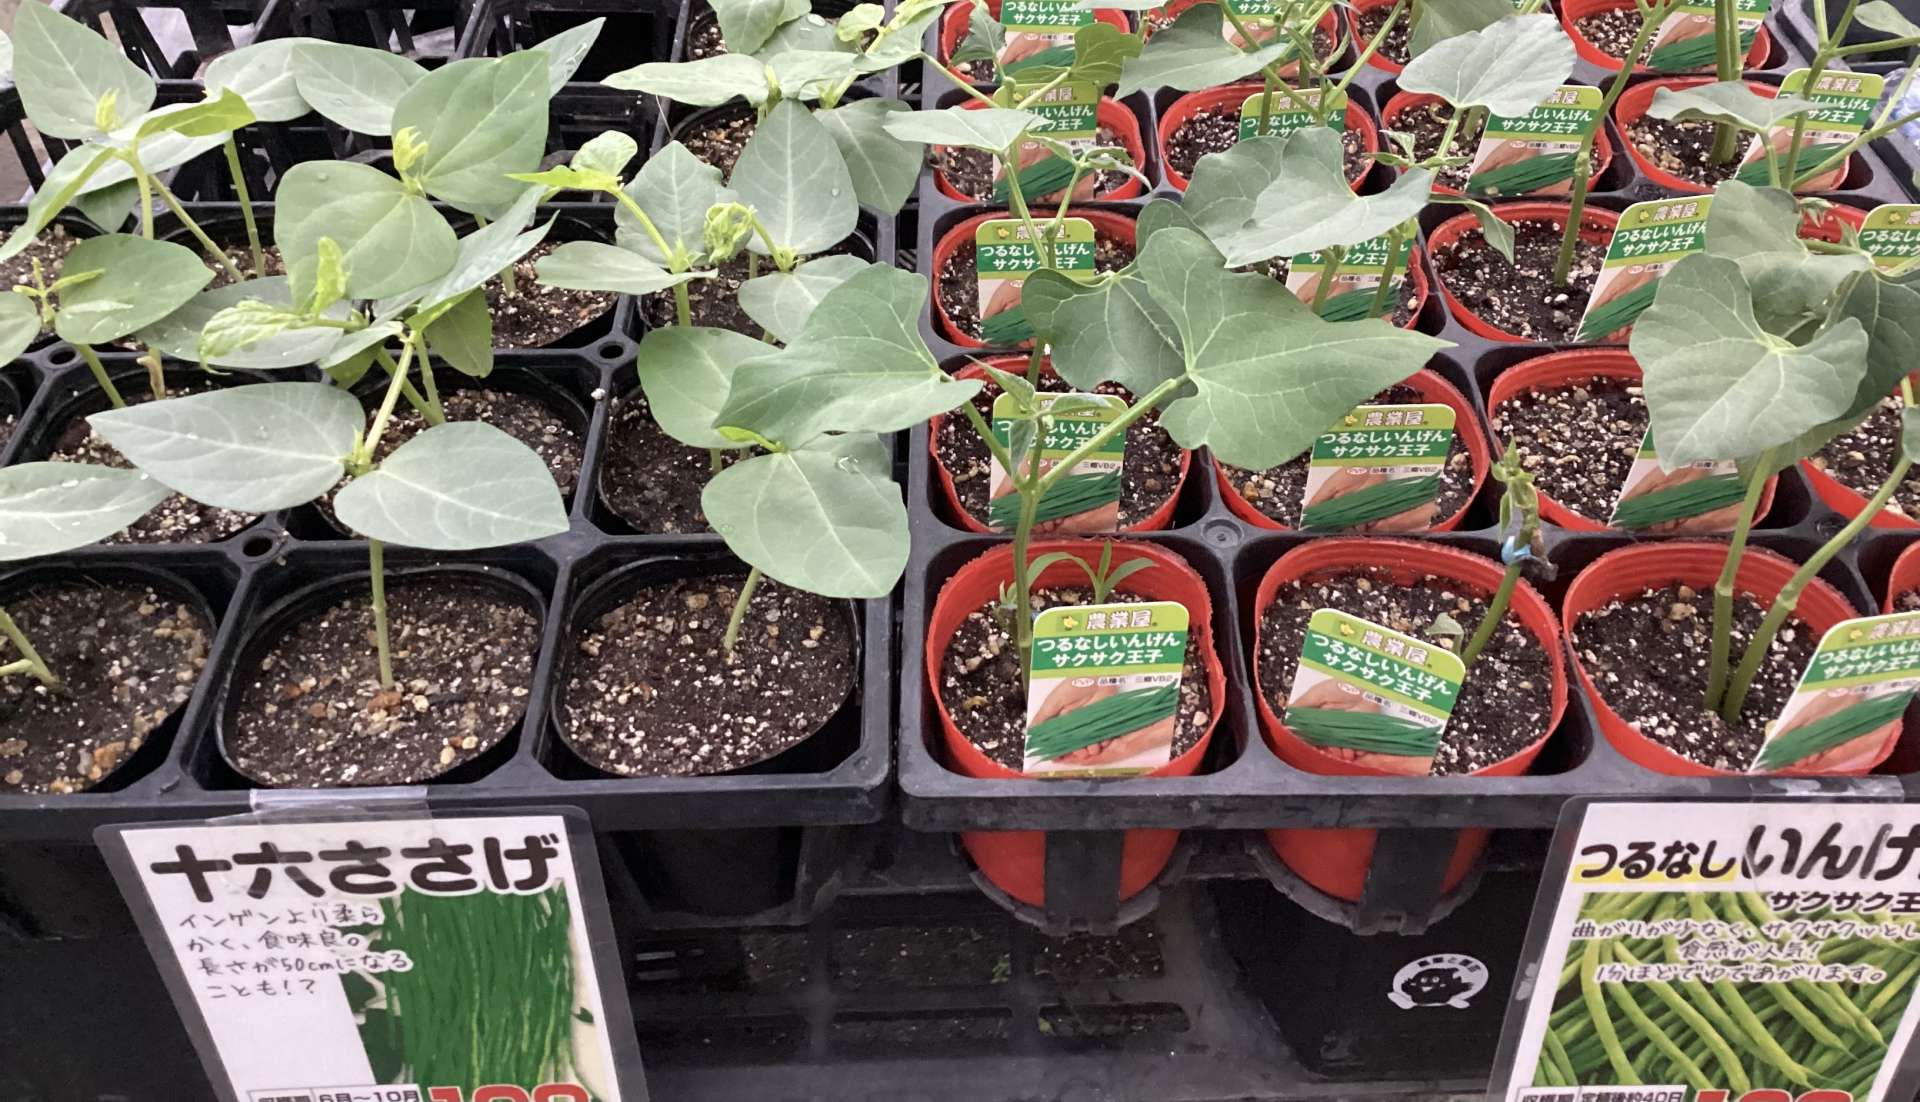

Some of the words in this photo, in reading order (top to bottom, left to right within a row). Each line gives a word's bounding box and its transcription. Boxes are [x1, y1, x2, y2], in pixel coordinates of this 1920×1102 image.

[1014, 14, 1081, 25] サクサク王子
[1502, 120, 1579, 134] サクサク王子
[1622, 237, 1695, 256] サクサク王子
[1365, 411, 1424, 426] 農業屋
[1321, 430, 1447, 444] つるなしいんげん
[1332, 444, 1431, 458] サクサク王子
[1086, 610, 1152, 630] 農業屋
[1038, 633, 1180, 652] つるなしいんげん
[1052, 649, 1164, 668] サクサク王子
[1312, 634, 1452, 695] つるなしいんげん
[1323, 653, 1432, 701] サクサク王子
[150, 833, 560, 903] 十六ささげ
[180, 904, 379, 927] インゲンより柔ら
[188, 930, 360, 952] かく、食味良。
[200, 953, 408, 976] 長さが50cmになる
